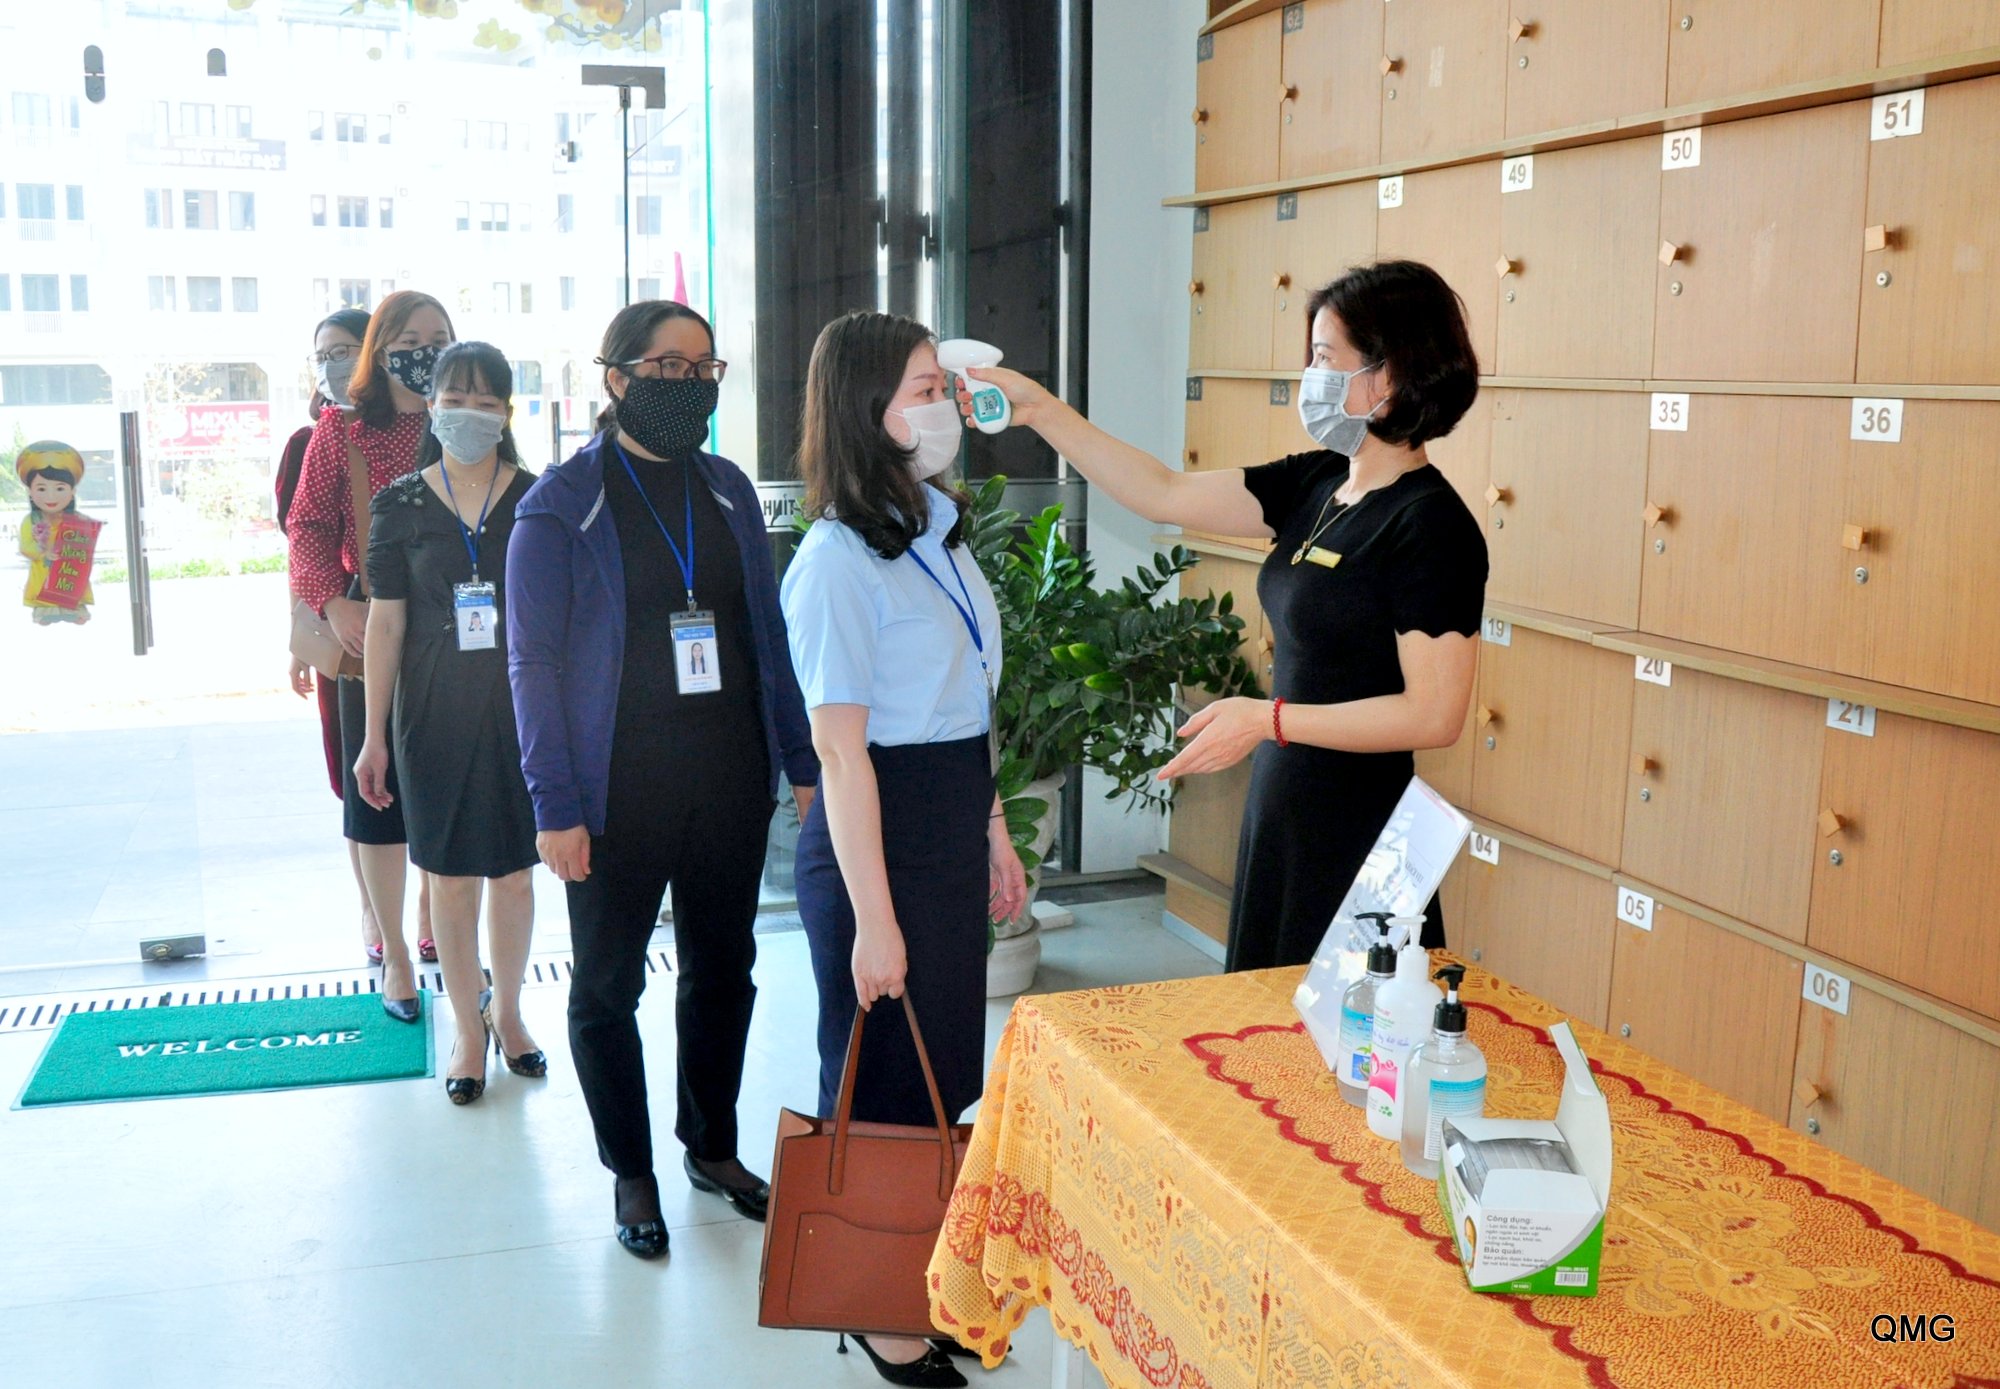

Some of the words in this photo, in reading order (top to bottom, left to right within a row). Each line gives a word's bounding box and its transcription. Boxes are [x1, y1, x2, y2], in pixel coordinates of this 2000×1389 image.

[1286, 9, 1301, 30] 62
[1883, 98, 1911, 129] 51
[1670, 137, 1693, 161] 50
[1508, 162, 1526, 185] 49
[1383, 183, 1398, 201] 48
[1280, 198, 1294, 216] 47
[1189, 381, 1199, 397] 31
[1658, 400, 1681, 424] 35
[1861, 407, 1891, 434] 36
[1488, 617, 1504, 638] 19
[1642, 656, 1664, 677] 20
[1839, 700, 1865, 726] 21
[1475, 834, 1491, 856] 04
[1625, 895, 1645, 921] 05
[1813, 972, 1840, 1003] 06
[116, 1029, 362, 1058] WELCOME
[1486, 1214, 1508, 1223] Công
[1510, 1216, 1533, 1225] dụng:
[1484, 1246, 1500, 1254] Bảo
